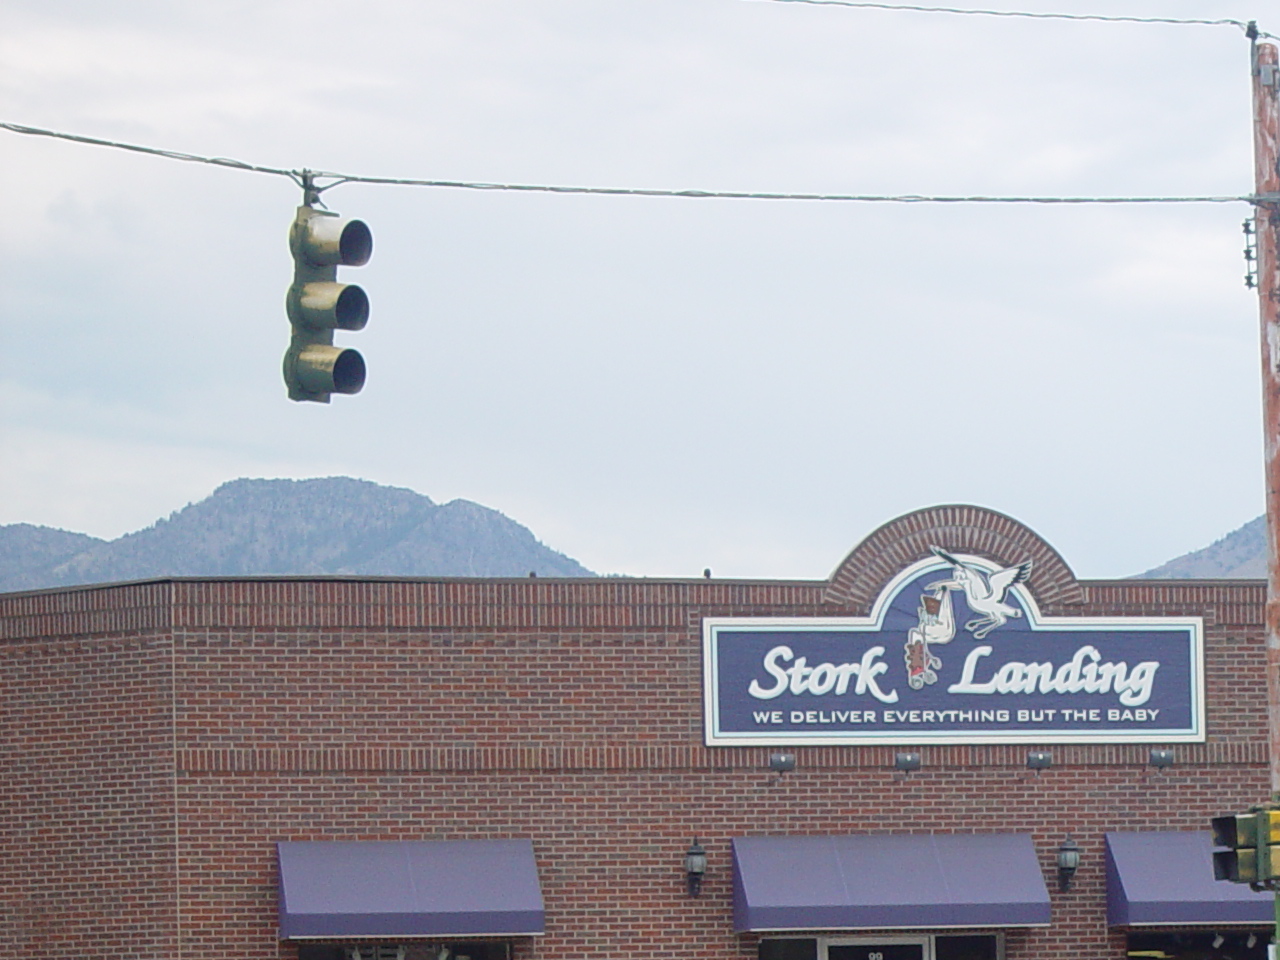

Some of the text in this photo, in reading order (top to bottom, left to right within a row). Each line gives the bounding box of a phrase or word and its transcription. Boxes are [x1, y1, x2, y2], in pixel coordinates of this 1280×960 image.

[749, 645, 1160, 706] Stork Landing
[753, 709, 1160, 723] WE DELIVER EVERYTHING BUT THE BABY
